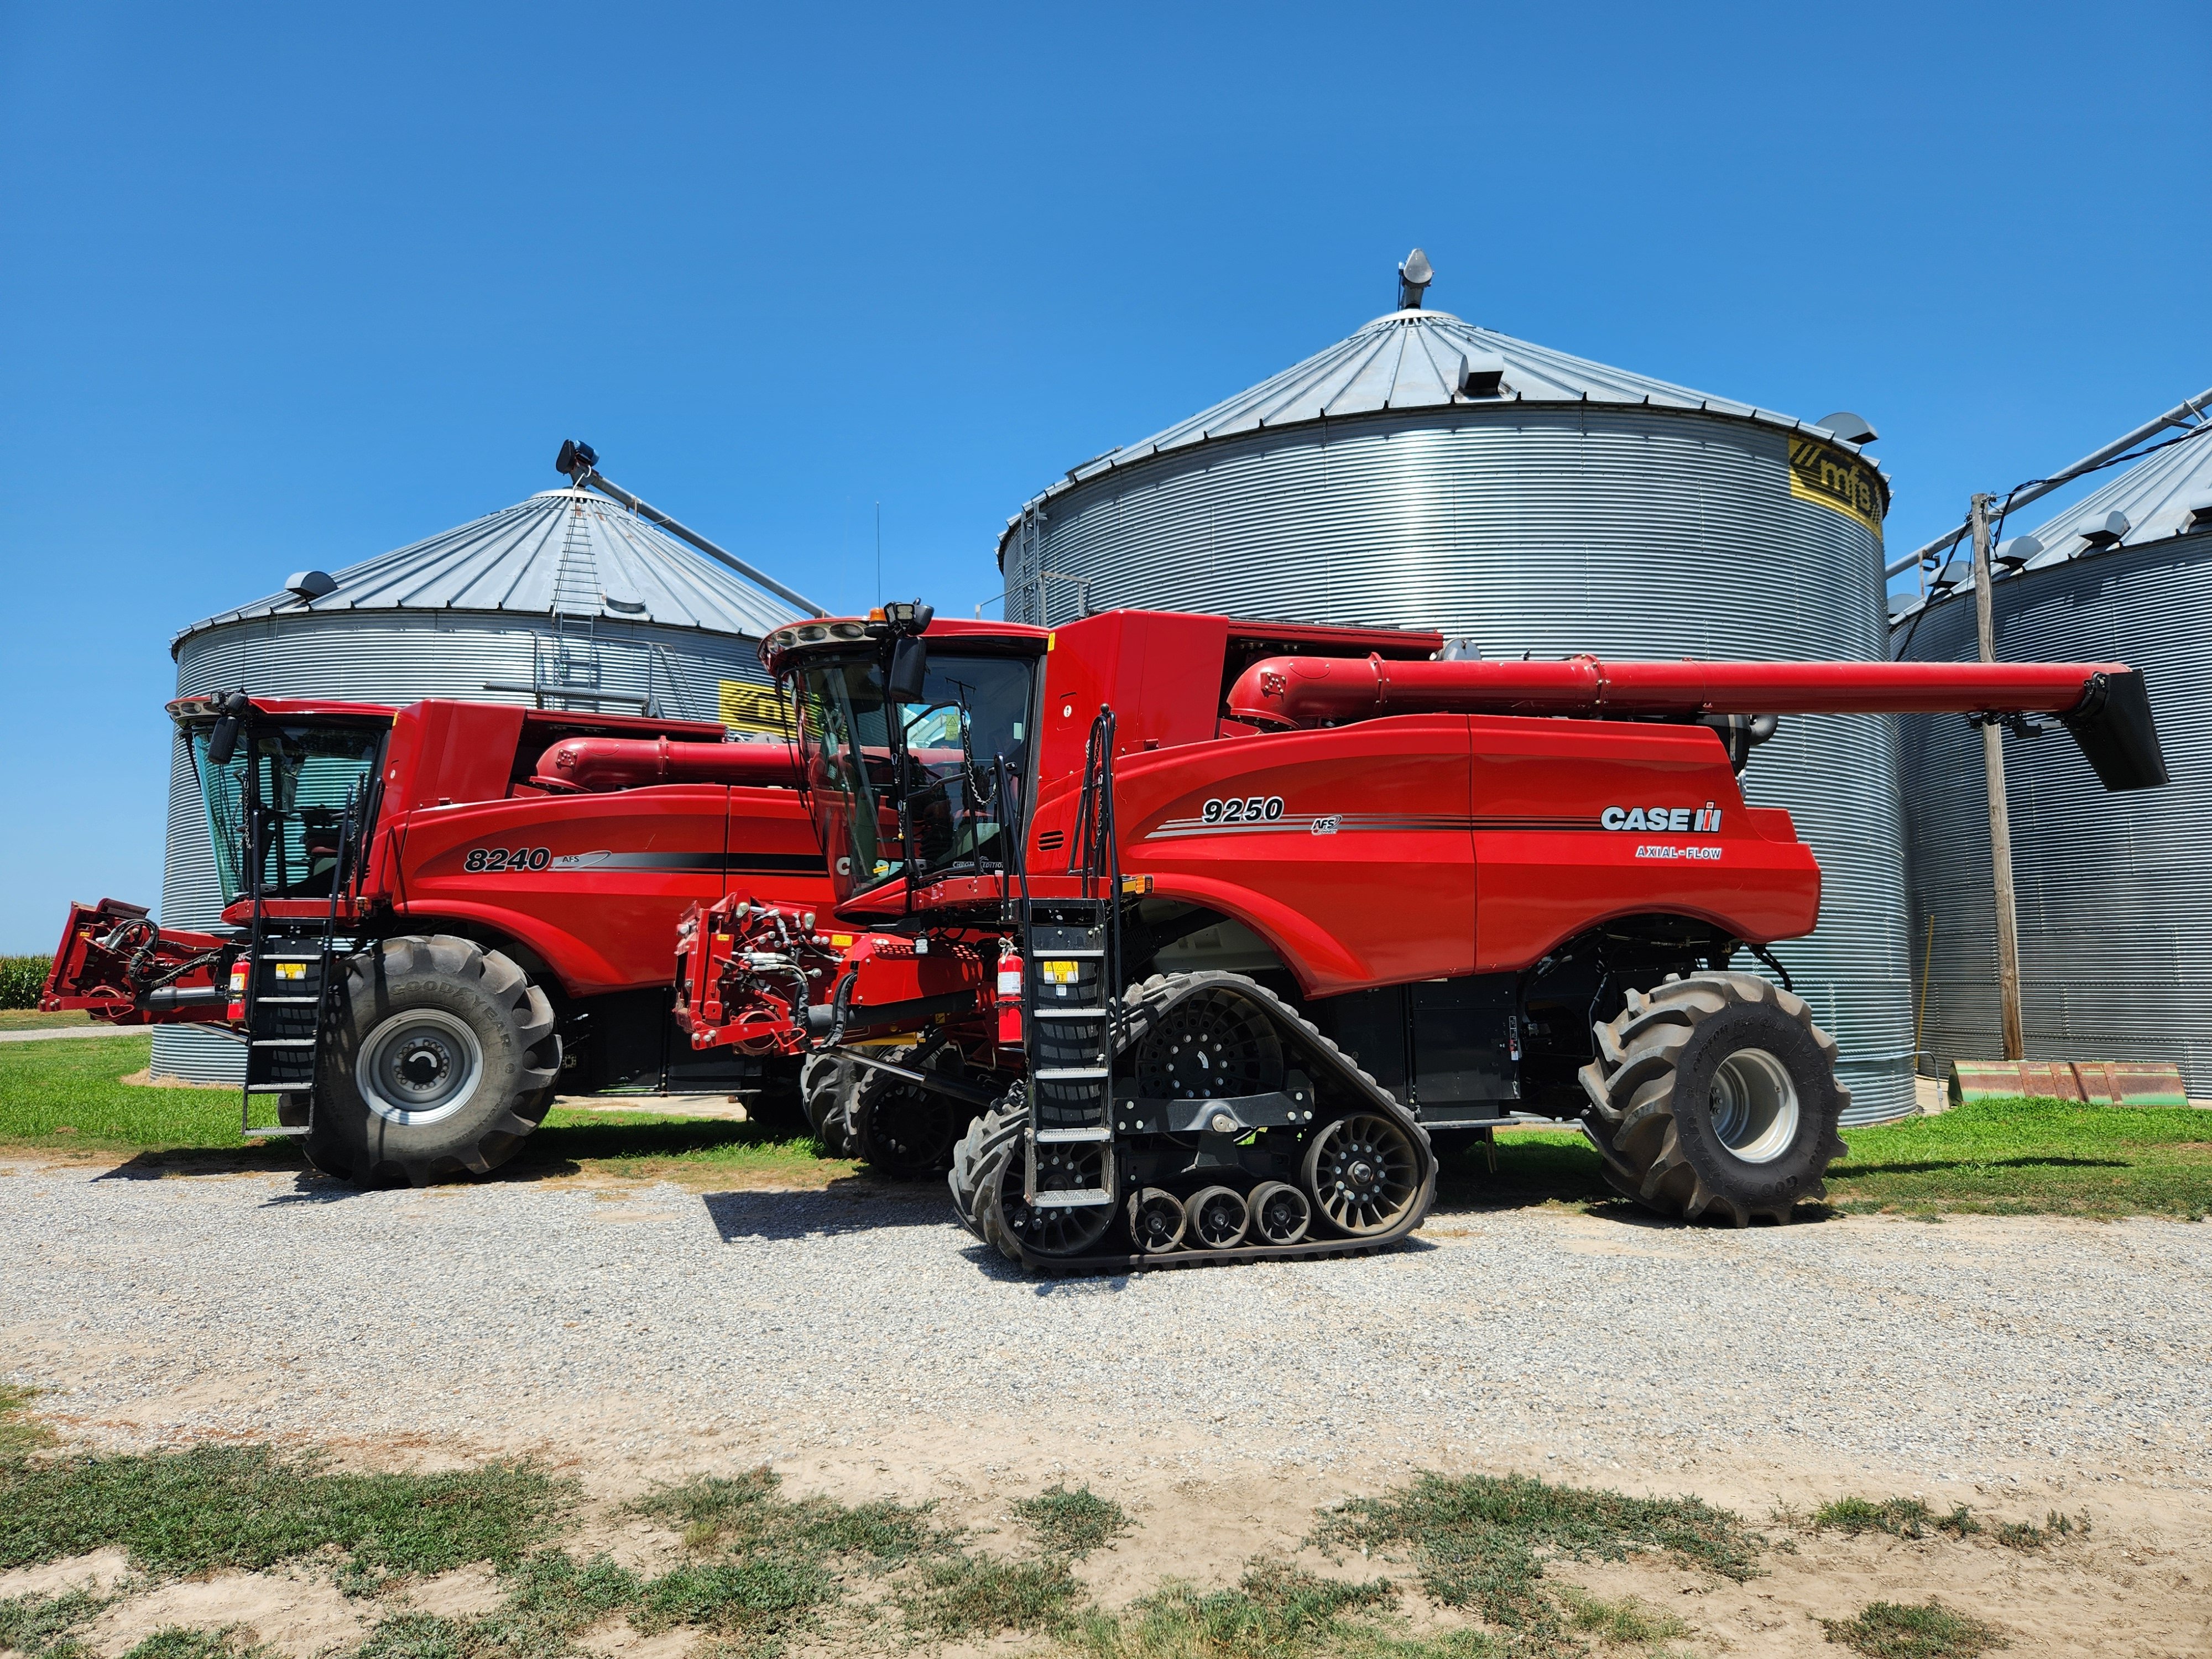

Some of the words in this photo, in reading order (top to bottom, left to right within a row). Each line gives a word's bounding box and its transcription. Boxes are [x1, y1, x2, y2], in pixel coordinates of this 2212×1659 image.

[1819, 458, 1872, 512] mfs
[1202, 796, 1284, 823] 9250
[1601, 806, 1691, 831] CASE
[1311, 817, 1335, 830] AFS
[464, 847, 551, 873] 8240
[1635, 846, 1721, 859] AXIAL-FLOW
[390, 980, 512, 1049] GOODYEAR
